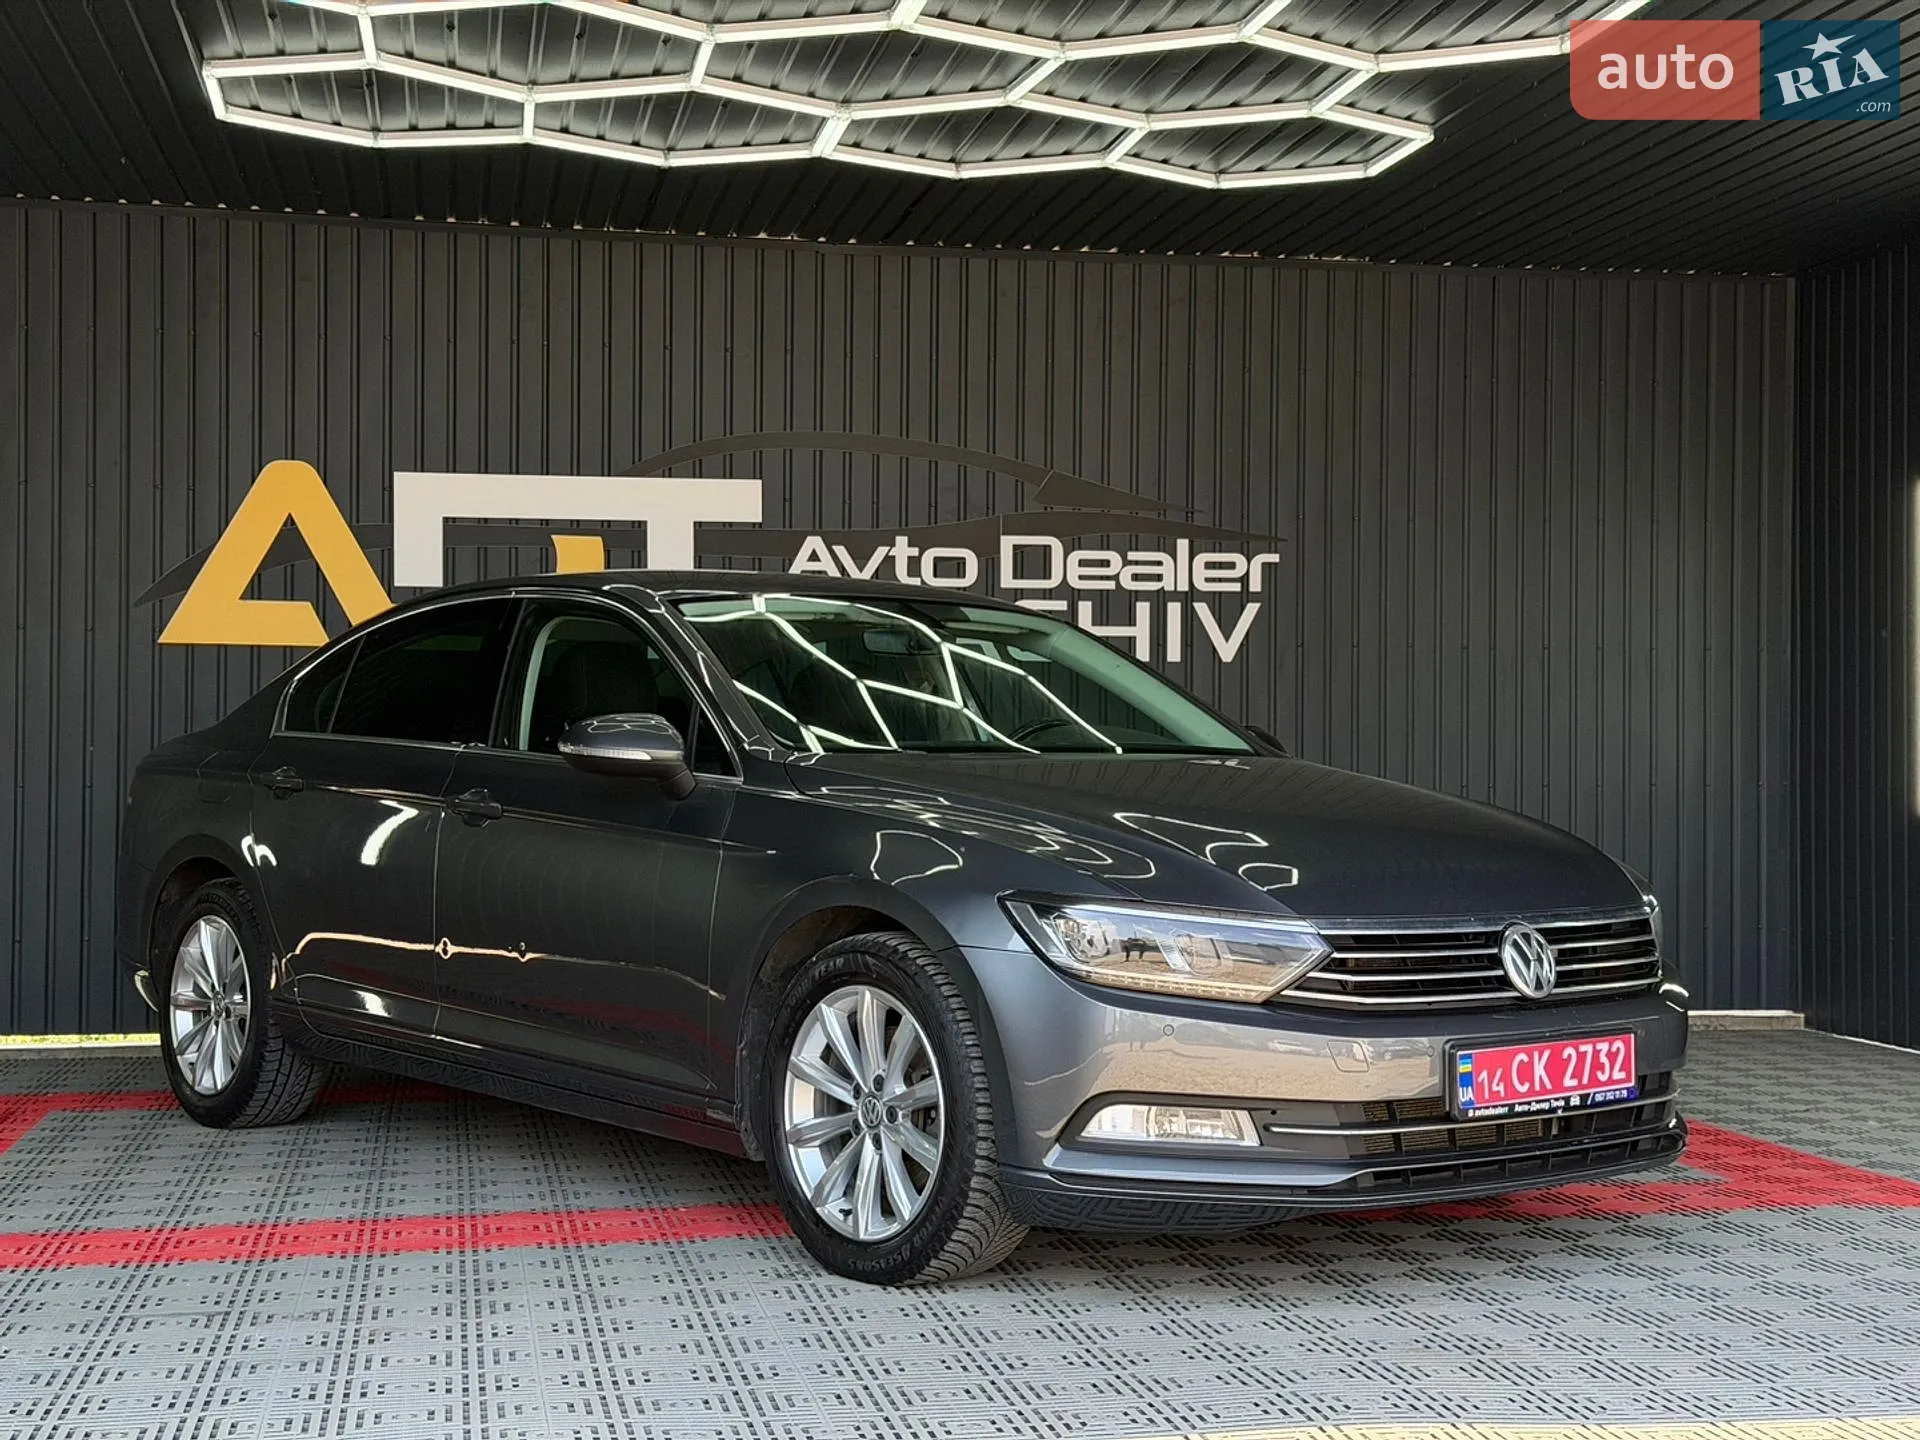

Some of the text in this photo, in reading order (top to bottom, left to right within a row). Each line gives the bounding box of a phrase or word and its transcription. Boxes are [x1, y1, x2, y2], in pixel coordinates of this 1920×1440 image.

[788, 535, 1280, 592] Avto Dealer
[1459, 1039, 1627, 1102] UA 14 CK 2732
